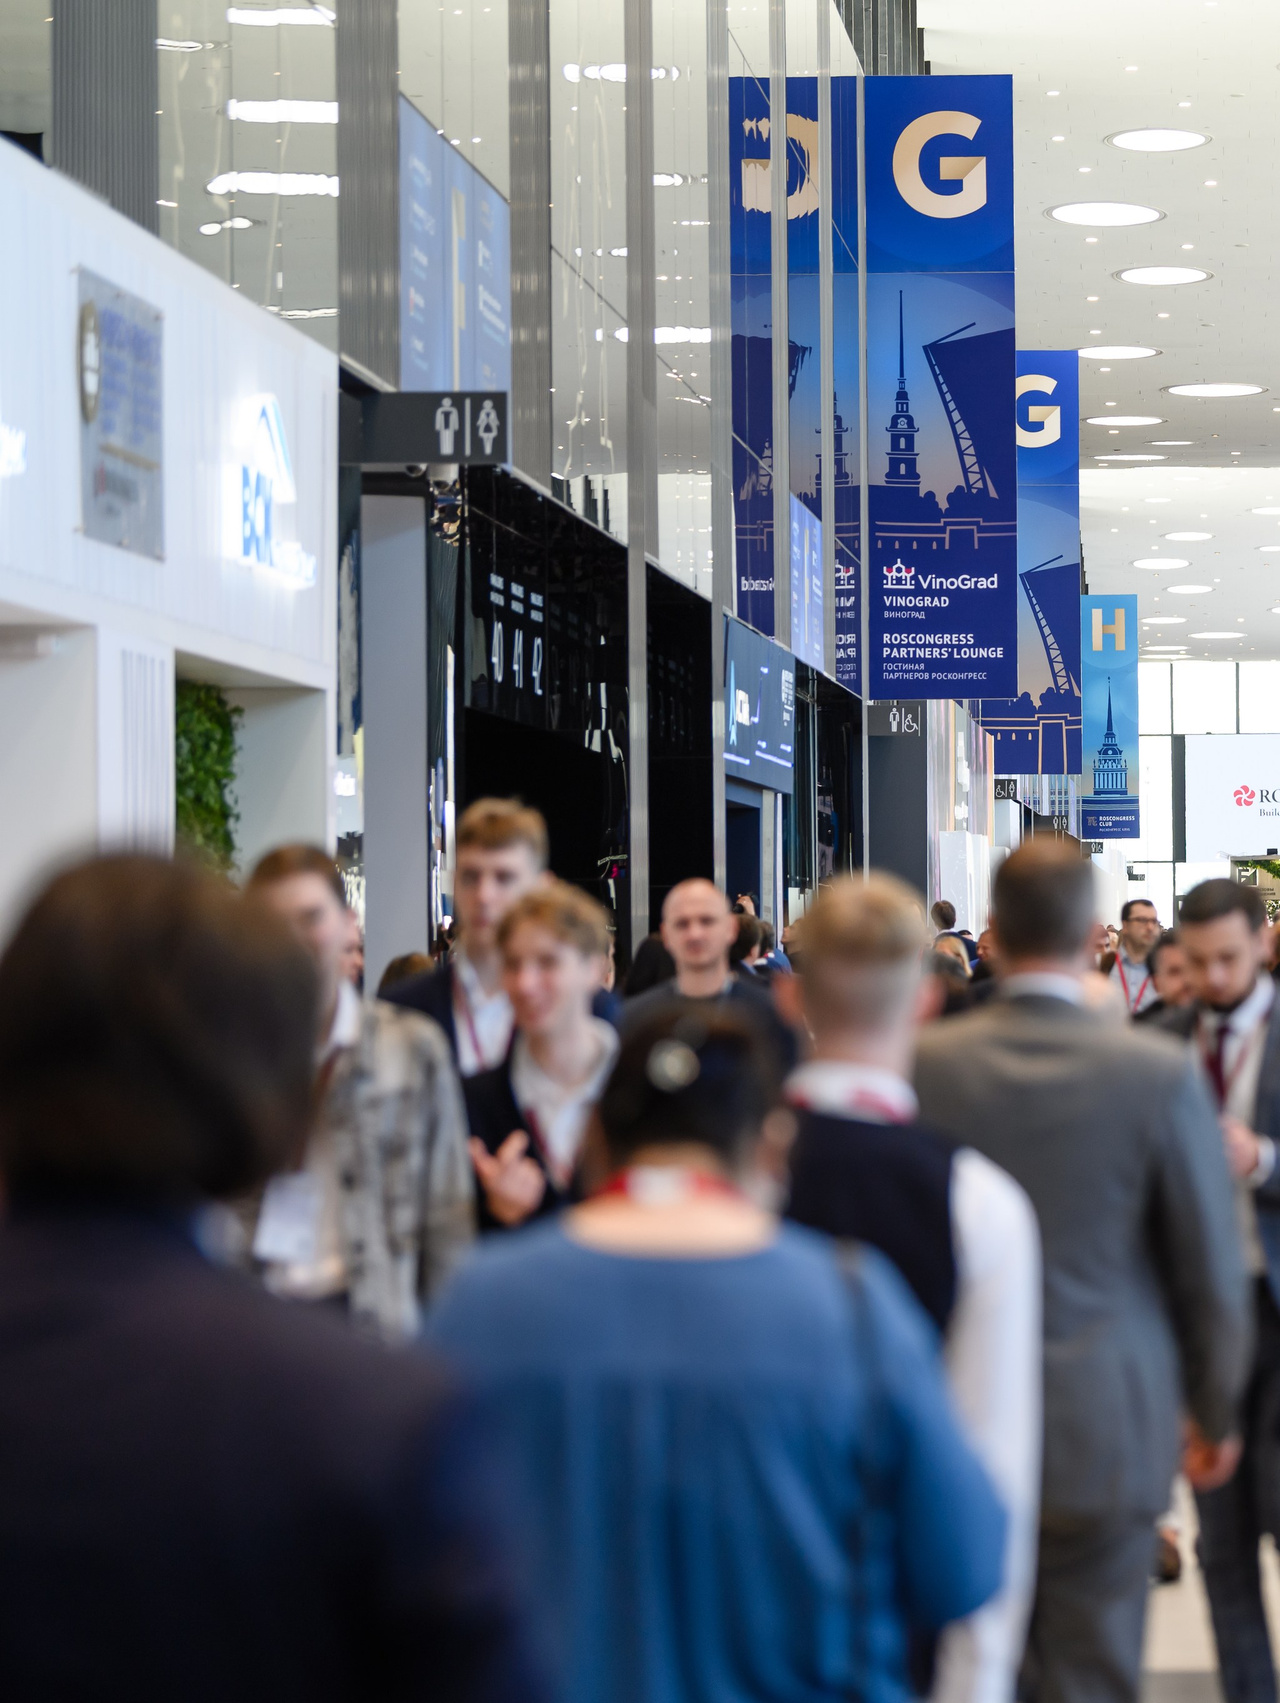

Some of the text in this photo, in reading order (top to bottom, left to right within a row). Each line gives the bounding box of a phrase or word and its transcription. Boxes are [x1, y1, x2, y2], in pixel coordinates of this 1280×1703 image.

[892, 110, 987, 219] G
[1015, 374, 1060, 448] G
[918, 573, 998, 589] VinoGrad
[883, 596, 949, 607] VINOGRAD
[884, 611, 925, 619] ВИНОГРАД
[883, 633, 974, 644] ROSCONGRESS
[1092, 608, 1125, 651] H
[491, 620, 504, 683] 40
[513, 628, 523, 689] 41
[532, 636, 543, 695] 42
[954, 647, 1003, 658] LOUNGE
[883, 672, 987, 680] ПАРТНЕРОВ РОСКОНГРЕСС
